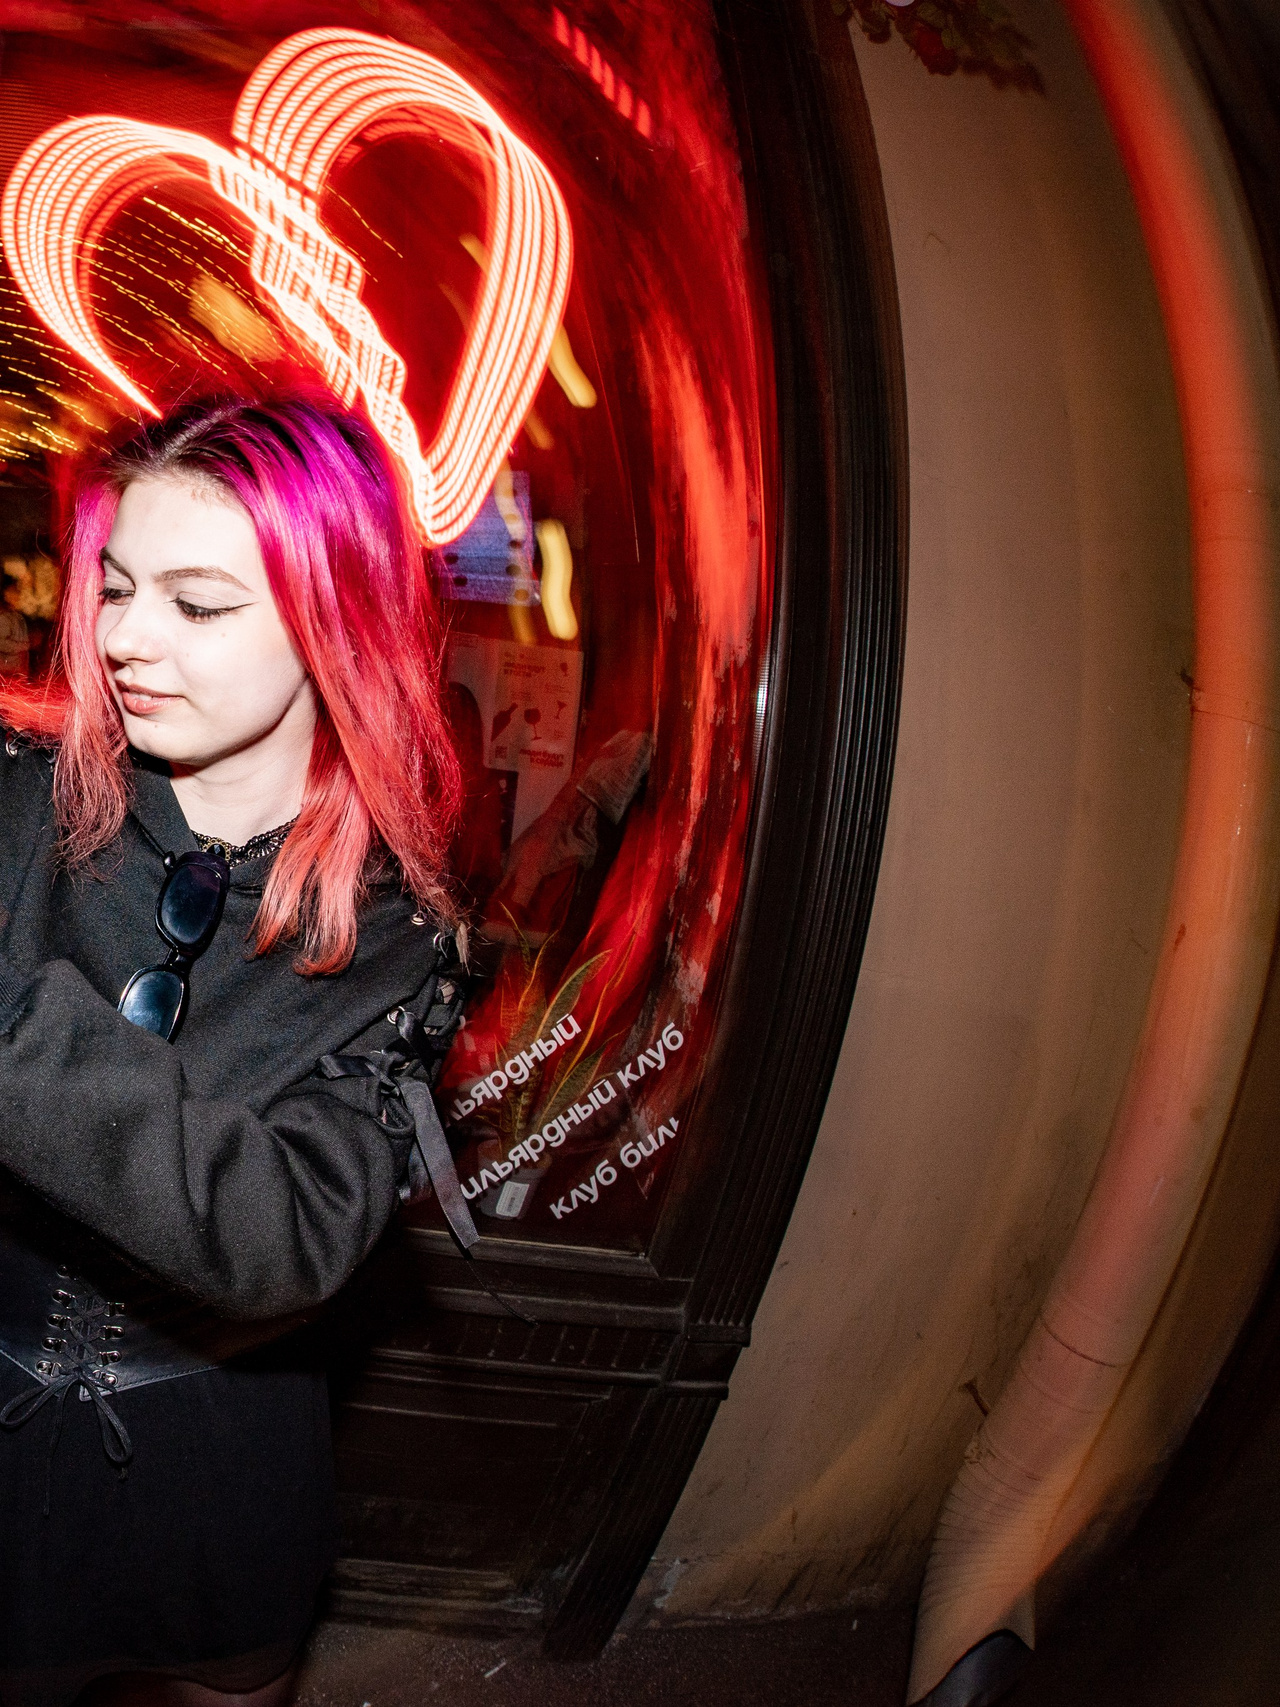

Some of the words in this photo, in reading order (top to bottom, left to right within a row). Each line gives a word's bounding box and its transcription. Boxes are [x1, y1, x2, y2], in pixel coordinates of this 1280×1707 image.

[459, 1078, 618, 1200] ильярдный
[616, 1021, 685, 1089] клуб
[549, 1158, 619, 1220] клуб
